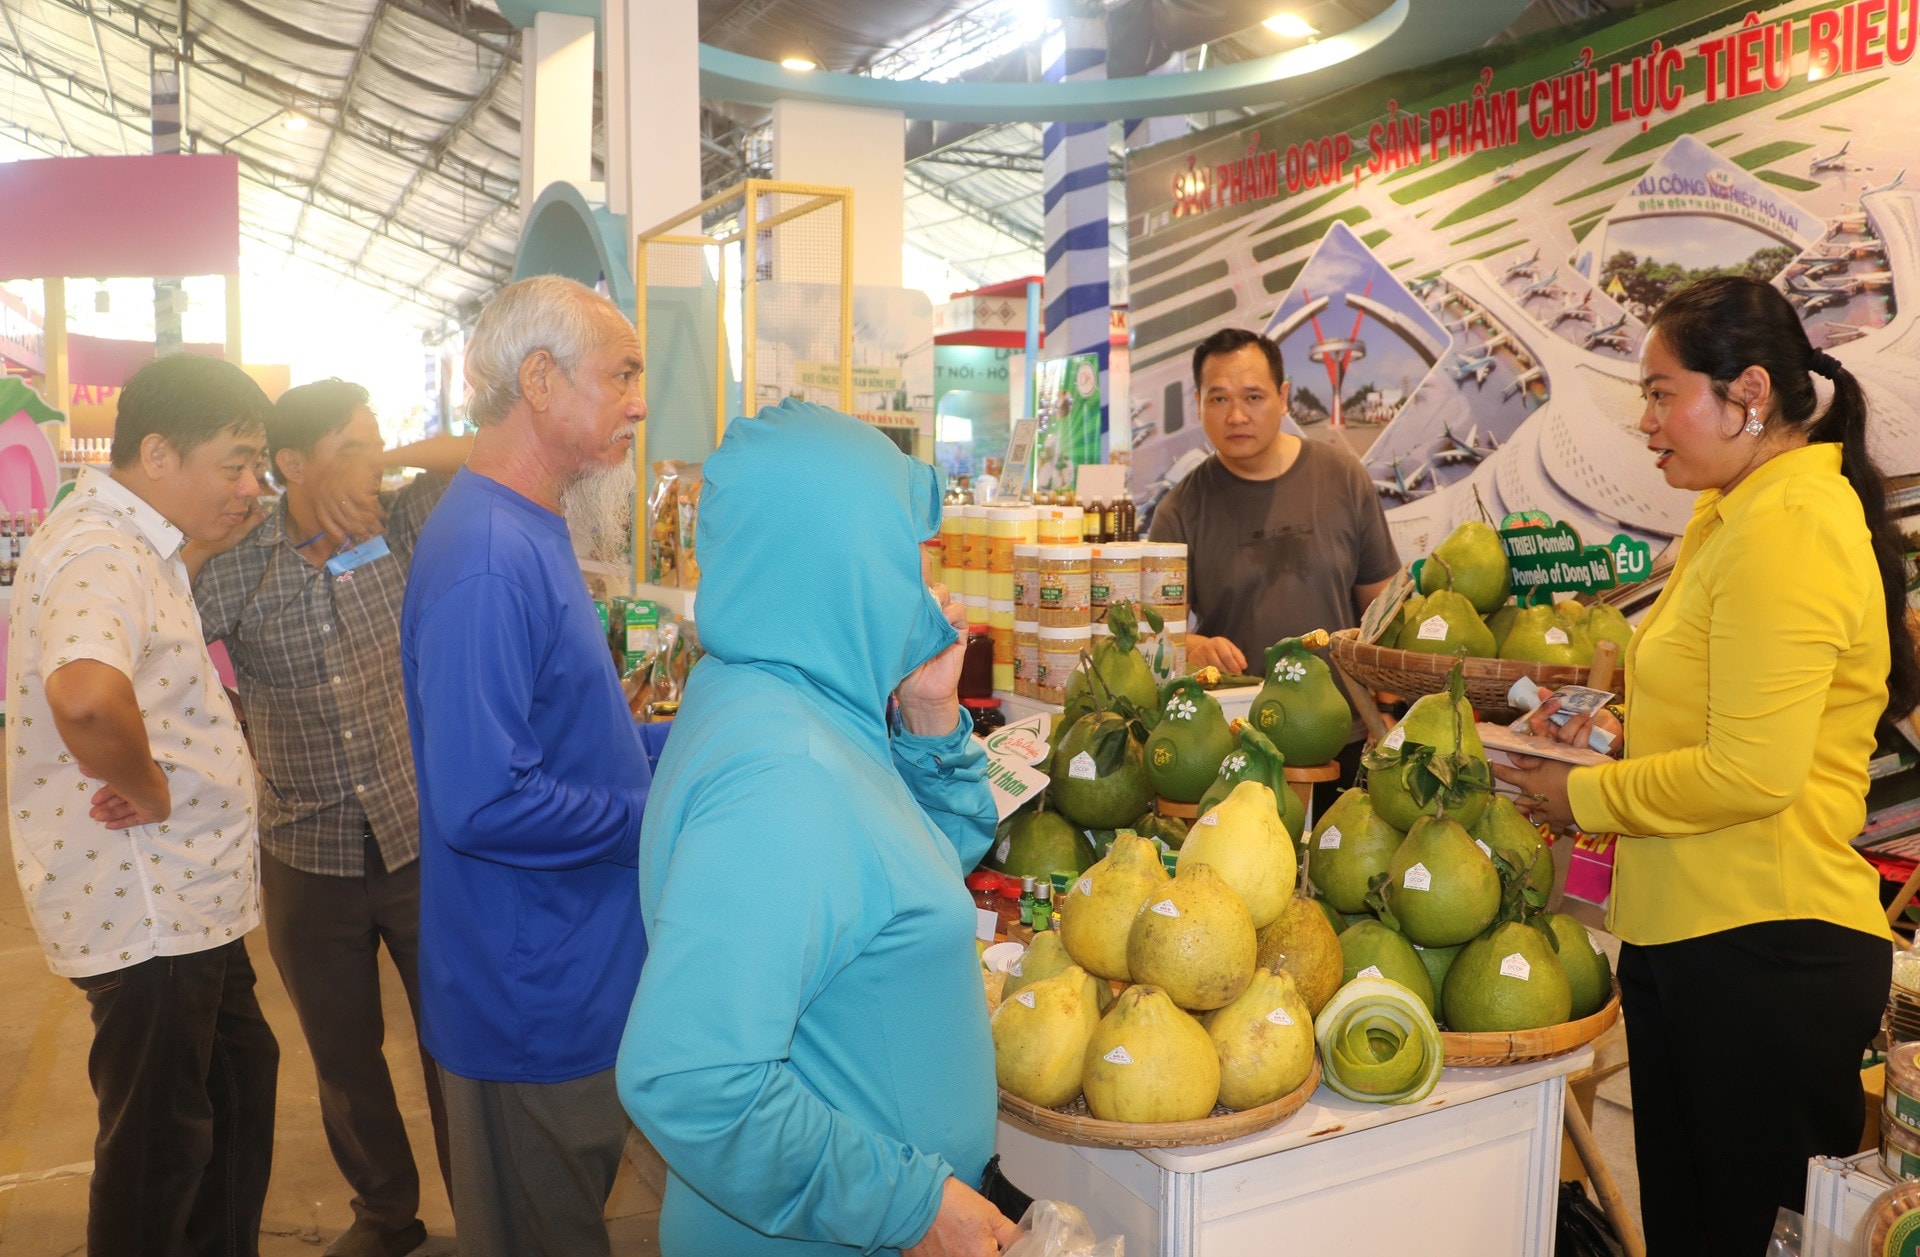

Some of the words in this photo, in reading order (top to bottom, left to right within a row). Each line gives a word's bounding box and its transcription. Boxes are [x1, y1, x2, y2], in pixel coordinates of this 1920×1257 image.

[1172, 154, 1211, 217] SẢN
[1215, 131, 1278, 208] PHẨM
[1367, 99, 1421, 175] SẢN
[1429, 66, 1518, 162] PHẨM
[1528, 46, 1598, 139] CHỦ
[1610, 39, 1684, 132] LỰC
[1698, 11, 1793, 104] TIÊU
[1659, 173, 1706, 196] CÔNG
[1779, 211, 1799, 232] NAI
[1508, 535, 1537, 556] TRIEU
[1536, 530, 1575, 553] Pomelo
[1512, 563, 1549, 587] Pomelo
[1550, 561, 1561, 583] of
[1561, 562, 1592, 587] Dong
[1589, 558, 1610, 581] Nai
